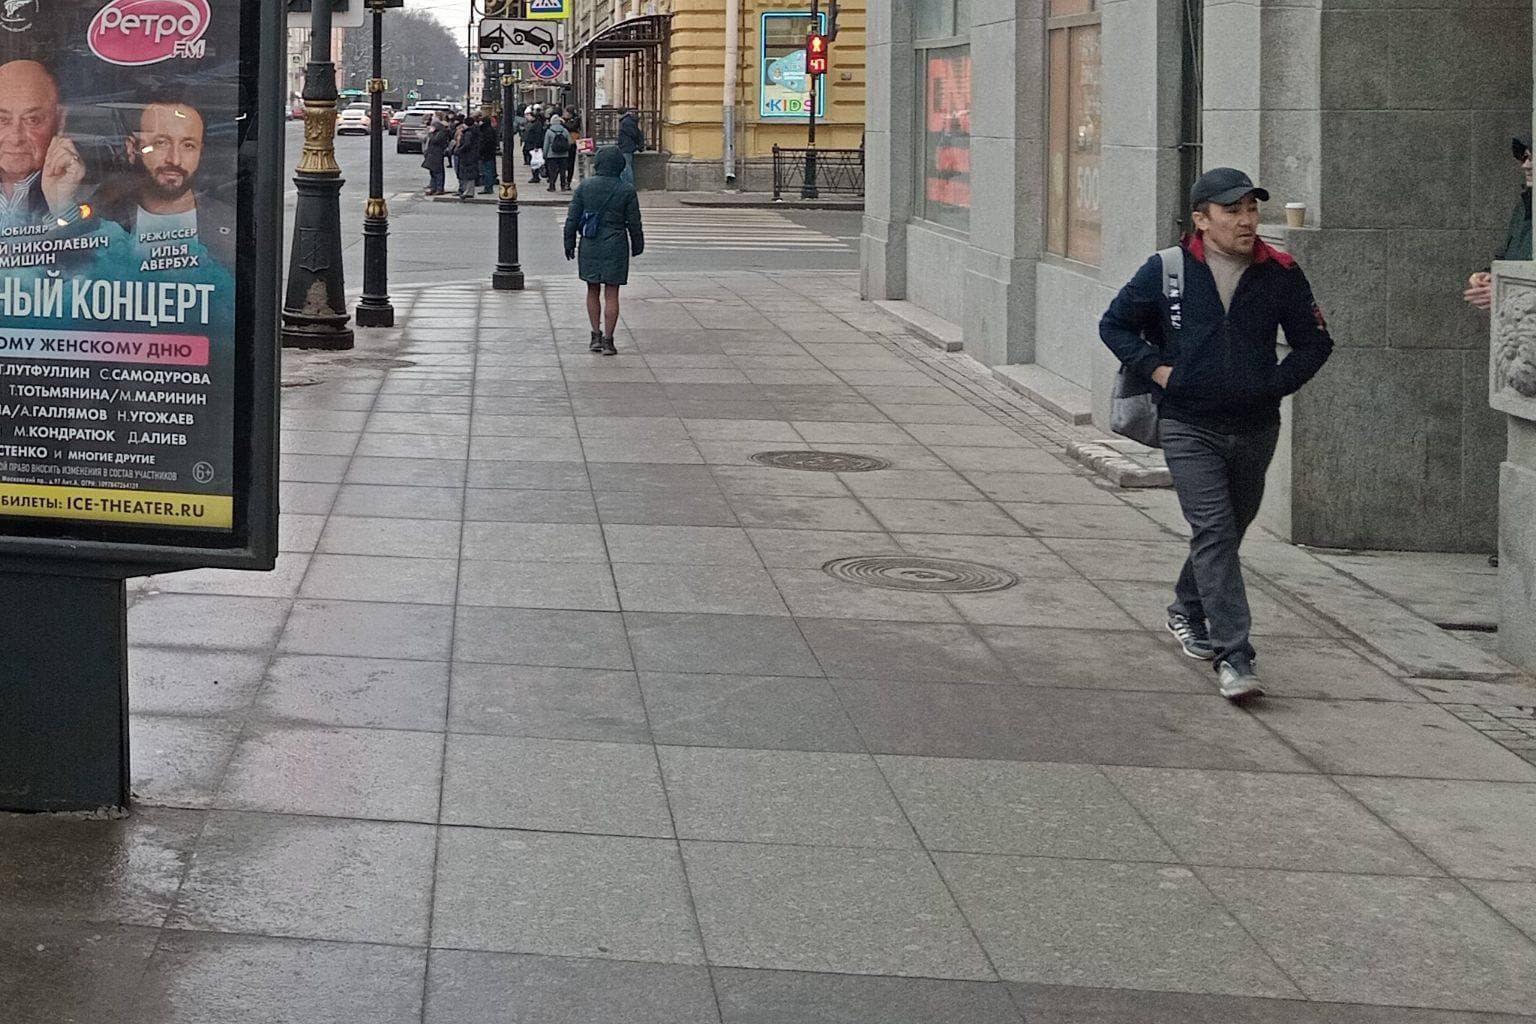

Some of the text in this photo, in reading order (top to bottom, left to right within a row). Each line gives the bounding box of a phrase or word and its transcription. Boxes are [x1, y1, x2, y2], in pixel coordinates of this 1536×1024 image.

[99, 6, 201, 44] Ретро
[172, 39, 206, 59] FM
[810, 58, 825, 70] 47
[770, 99, 815, 112] KIDS
[0, 224, 49, 237] ЮБИЛЯР
[11, 235, 110, 254] НИКОЛАЕВИЧ
[150, 244, 189, 258] ИЛЬЯ
[139, 255, 200, 272] АВЕРБУХ
[70, 278, 216, 327] КОНЦЕРТ
[40, 338, 143, 355] ЖЕНСКОМУ
[146, 342, 193, 359] ДНЮ
[99, 367, 212, 385] С.САМОДУРОВА
[8, 383, 208, 406] Т.ТОТЬМЯНИНА/М.МАРИНИН
[117, 410, 195, 426] Н.УГОЖАЕВ
[13, 426, 116, 442] М.КОНДРАТЮК
[127, 431, 188, 446] Д.АЛИЕВ
[67, 450, 114, 462] МНОГИЕ
[114, 453, 156, 465] ДРУГИЕ
[196, 465, 213, 481] 6+
[1, 495, 63, 510] БИЛЕТЫ:
[66, 496, 205, 518] ICE-THEATER.RU
